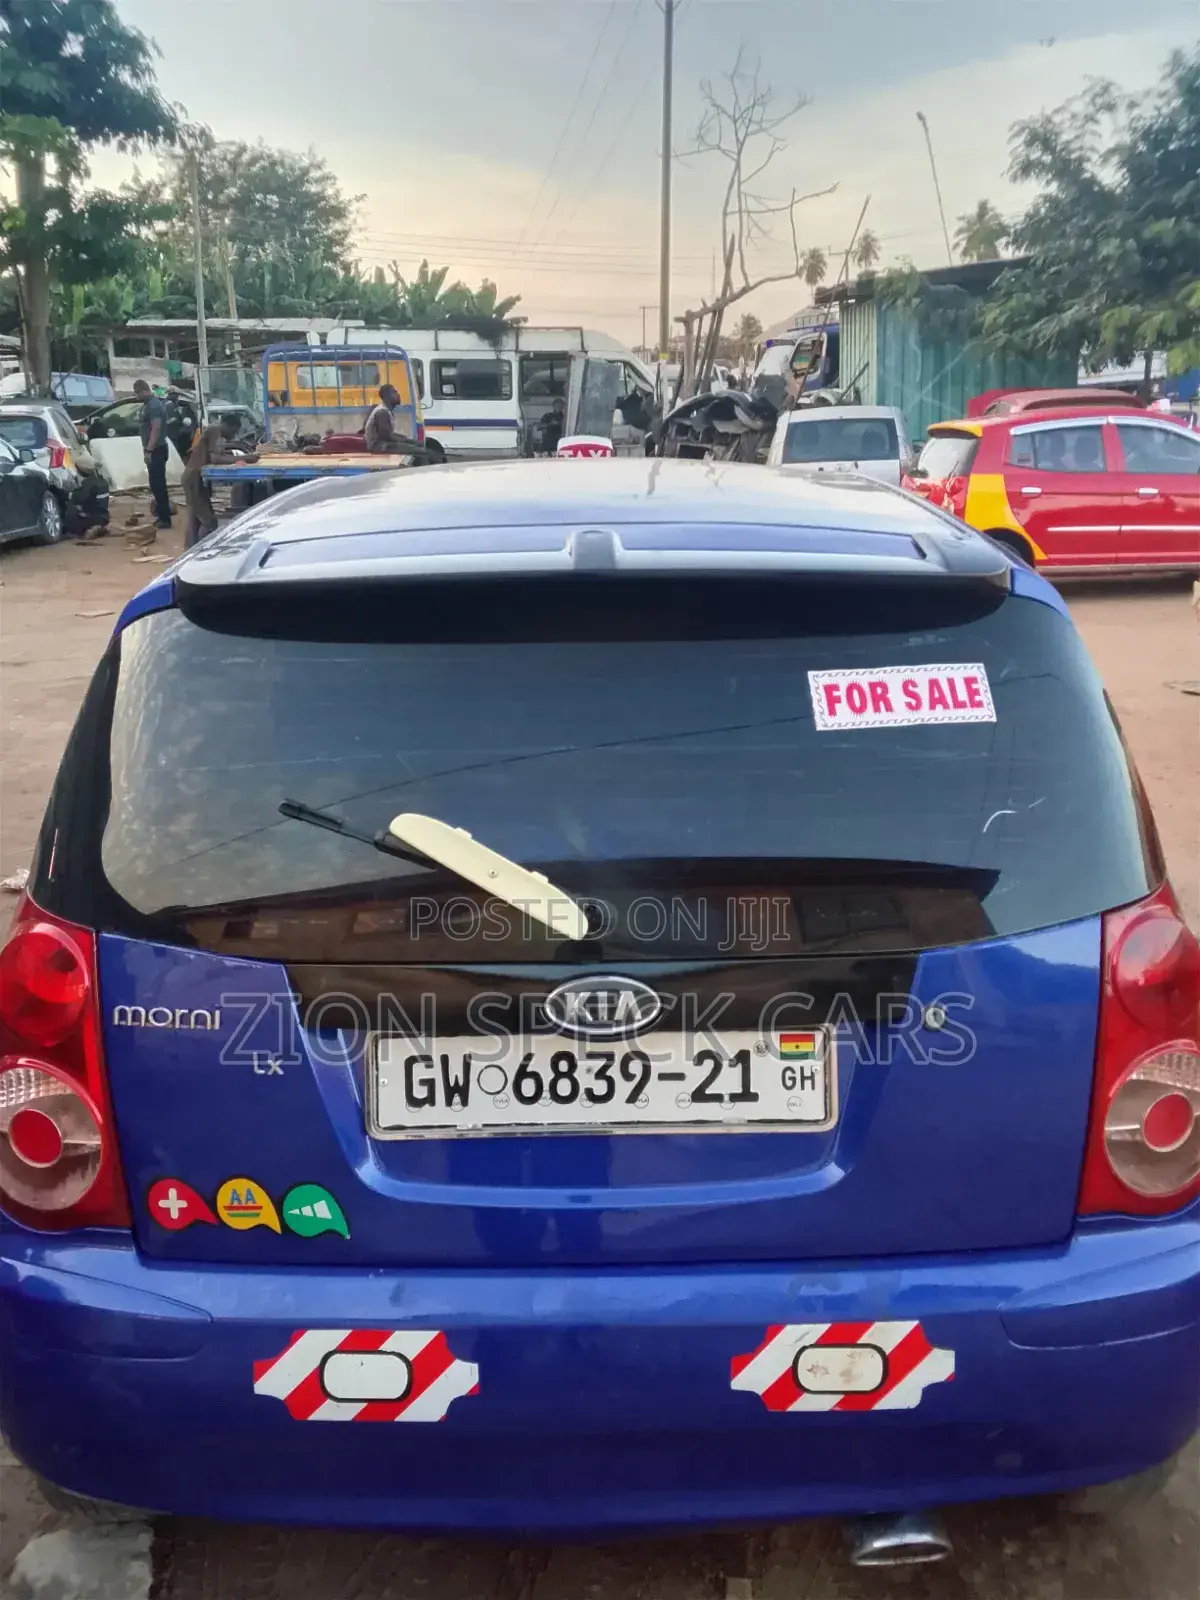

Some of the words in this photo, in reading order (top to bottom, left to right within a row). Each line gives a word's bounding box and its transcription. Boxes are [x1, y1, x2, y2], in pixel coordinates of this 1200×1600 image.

[822, 680, 895, 718] FOR
[902, 676, 985, 712] SALE
[112, 1003, 221, 1031] morni
[564, 990, 643, 1021] KIA
[404, 1053, 471, 1108] GW
[512, 1048, 760, 1106] 6839-21
[780, 1064, 816, 1092] GH
